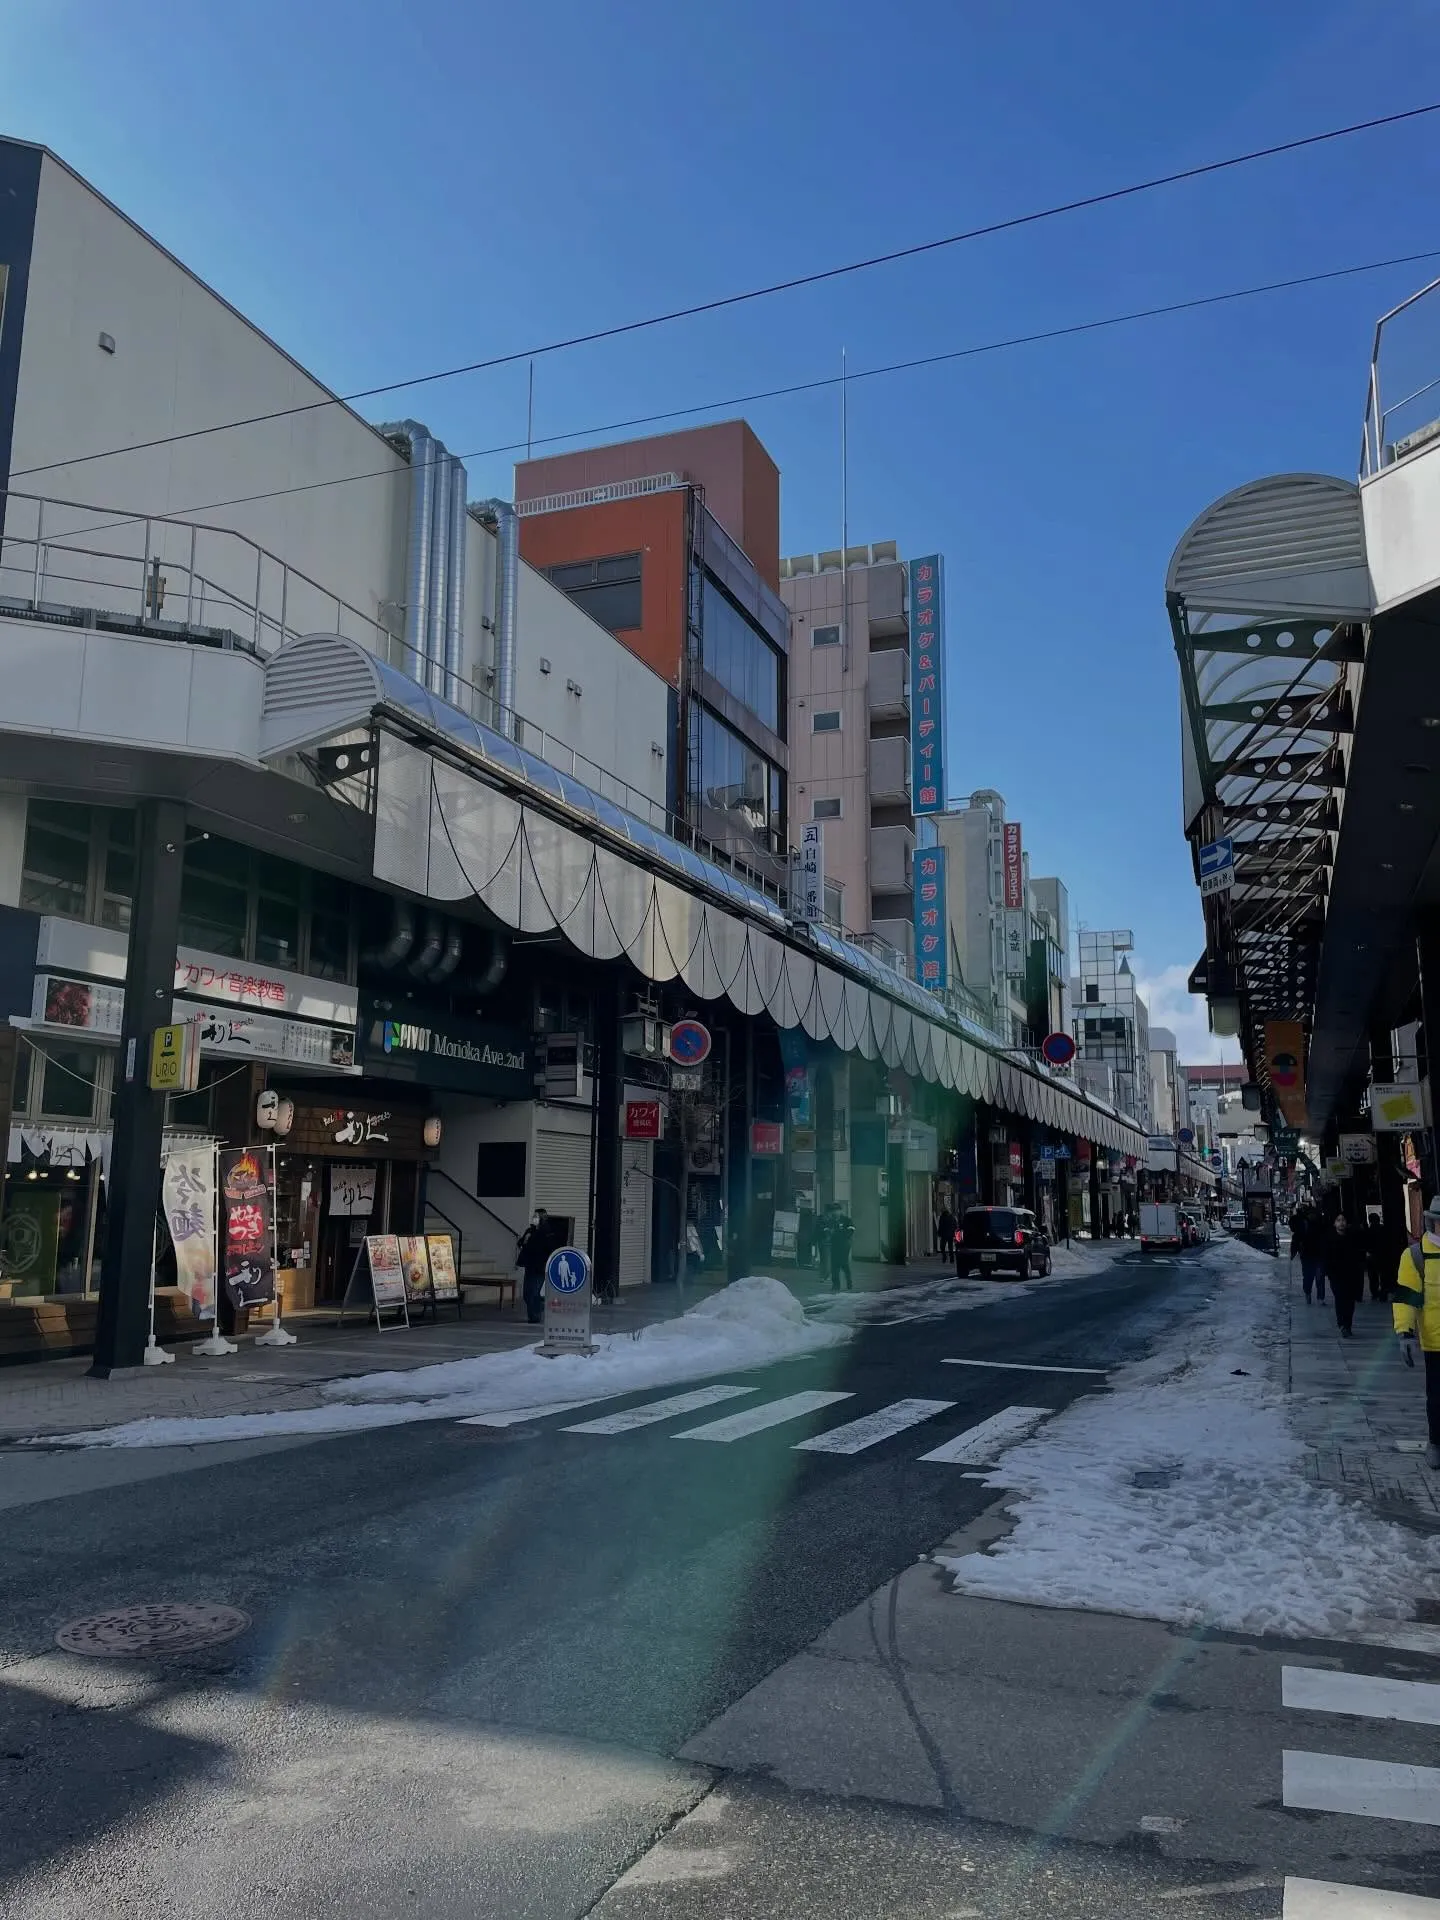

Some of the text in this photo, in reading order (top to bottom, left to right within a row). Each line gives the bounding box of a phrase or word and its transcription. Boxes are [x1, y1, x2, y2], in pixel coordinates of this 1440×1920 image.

[920, 857, 940, 979] カラオケ館
[183, 963, 286, 1002] カワイ音楽教室
[399, 1023, 432, 1052] PIVOT
[433, 1033, 481, 1061] Morioka
[628, 1106, 658, 1119] カワイ
